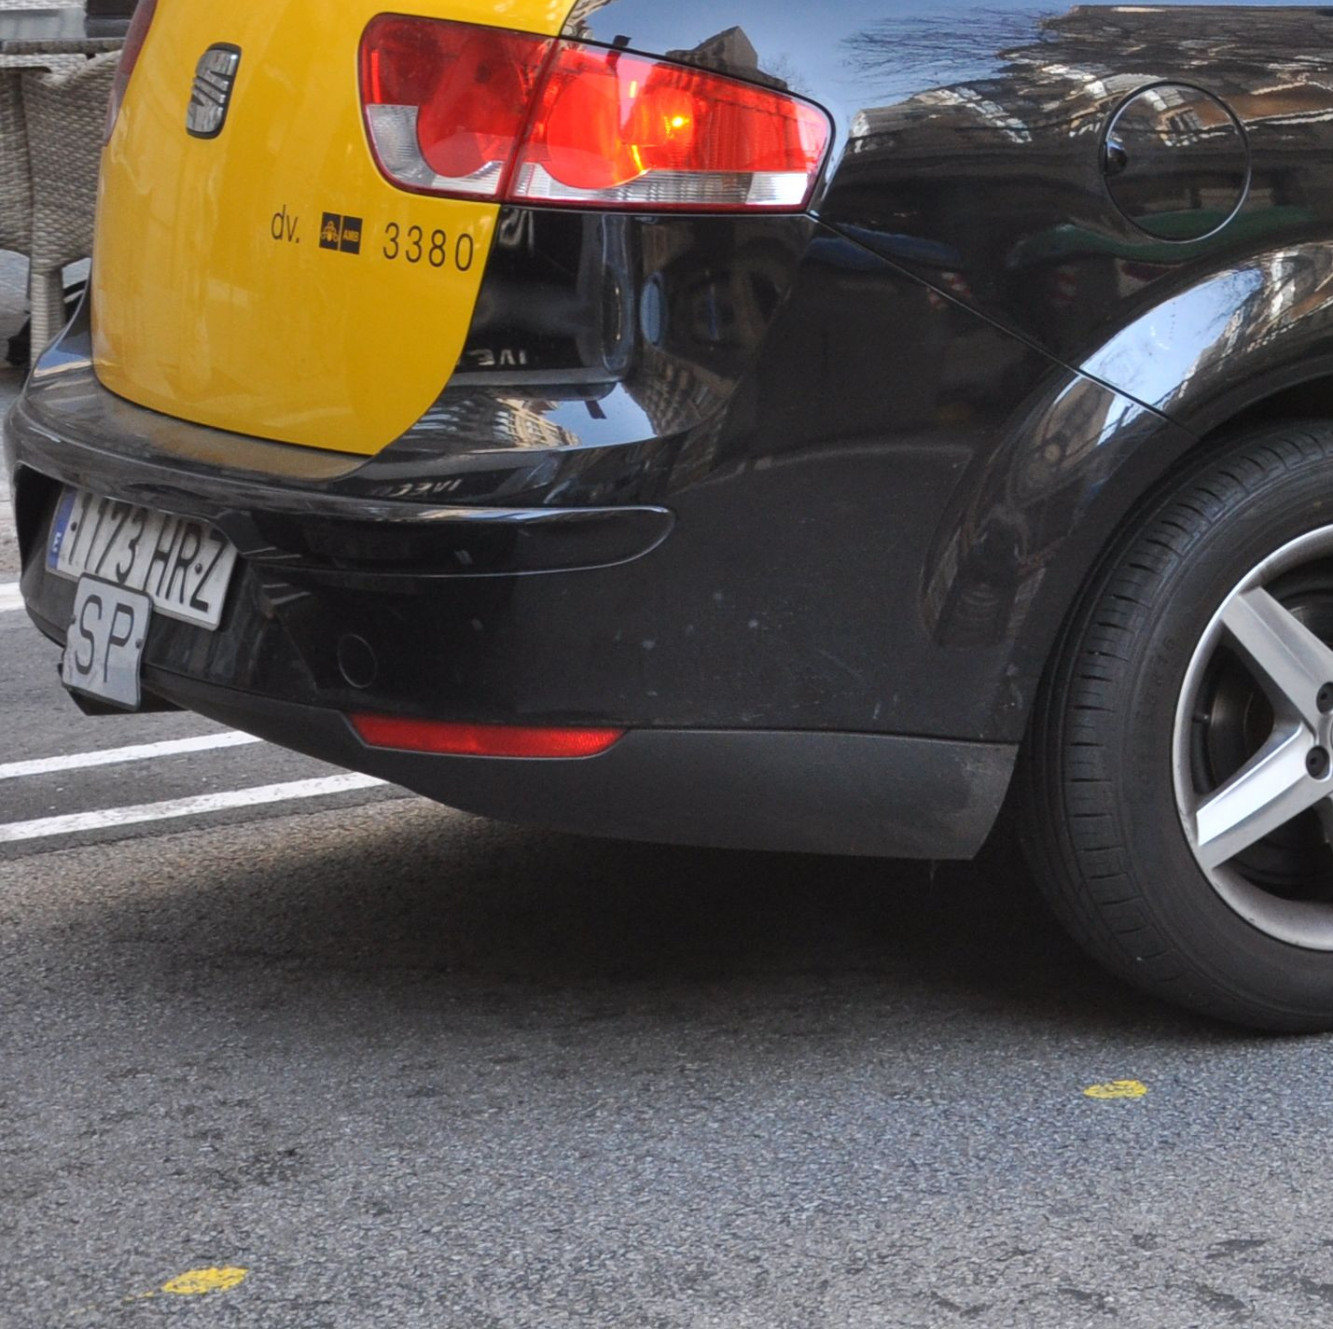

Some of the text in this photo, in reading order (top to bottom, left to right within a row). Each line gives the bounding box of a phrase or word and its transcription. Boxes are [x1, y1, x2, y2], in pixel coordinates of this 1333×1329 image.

[270, 204, 301, 244] dv.
[382, 221, 475, 272] 3380
[68, 491, 151, 587] 1173
[143, 514, 227, 614] HRZ
[74, 593, 135, 684] SP
